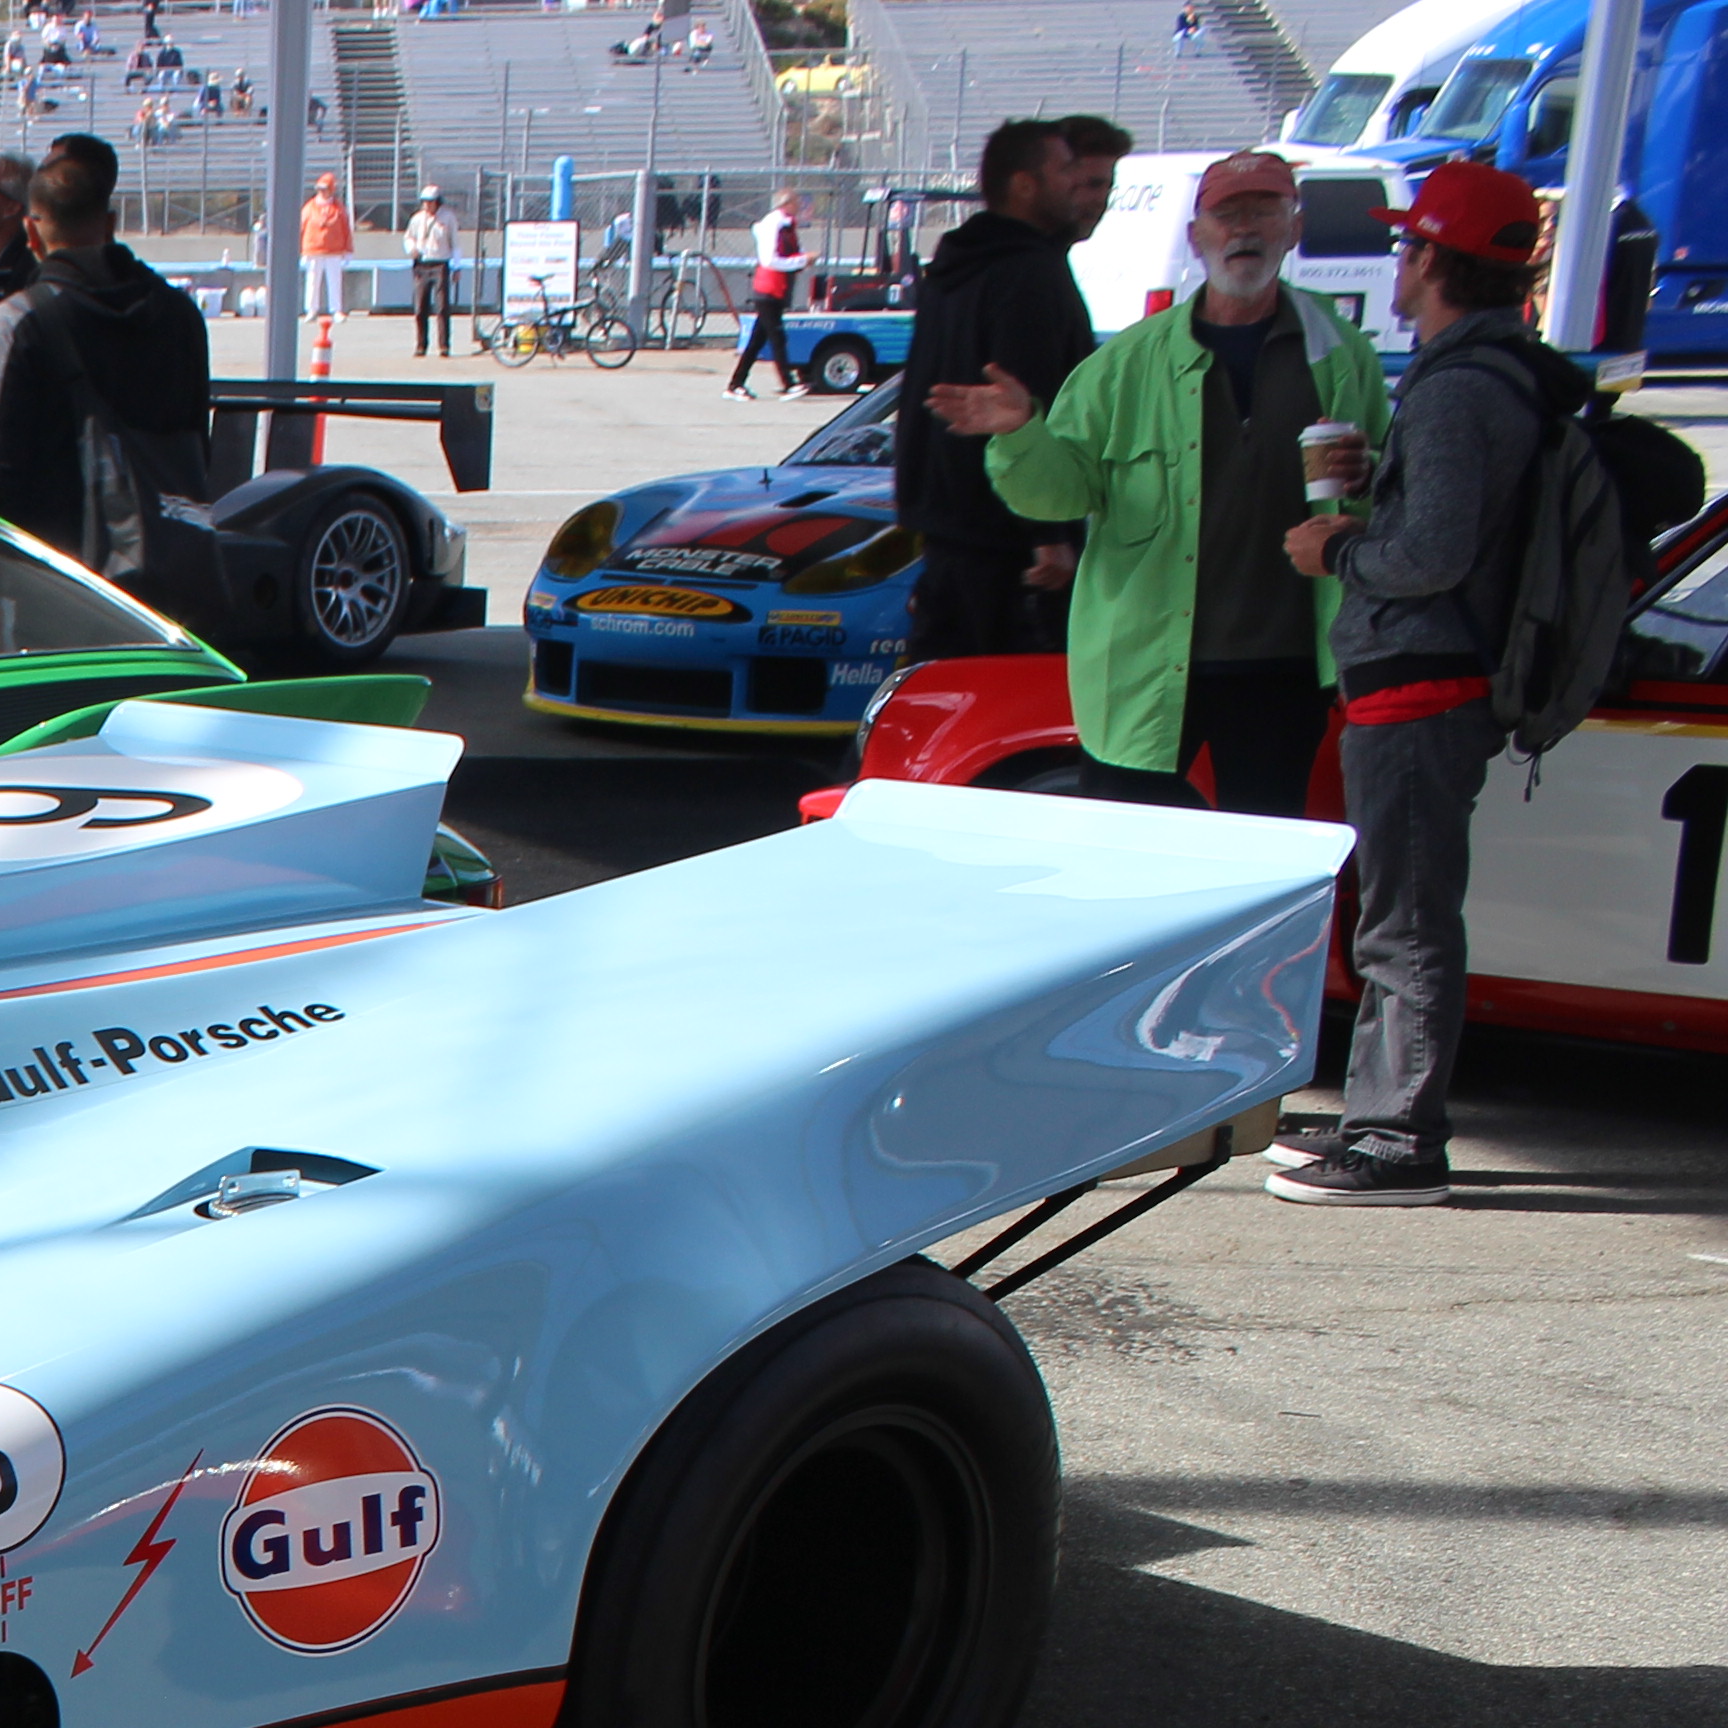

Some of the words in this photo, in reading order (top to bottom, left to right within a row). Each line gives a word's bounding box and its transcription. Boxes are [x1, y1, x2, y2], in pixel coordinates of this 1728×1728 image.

[625, 547, 783, 569] MONSTER
[636, 559, 742, 576] CABLE
[589, 586, 721, 613] UNICHIP
[591, 613, 695, 638] schrom.com
[780, 624, 847, 647] PAGID
[830, 661, 884, 686] Hella
[231, 1485, 427, 1580] Gulf
